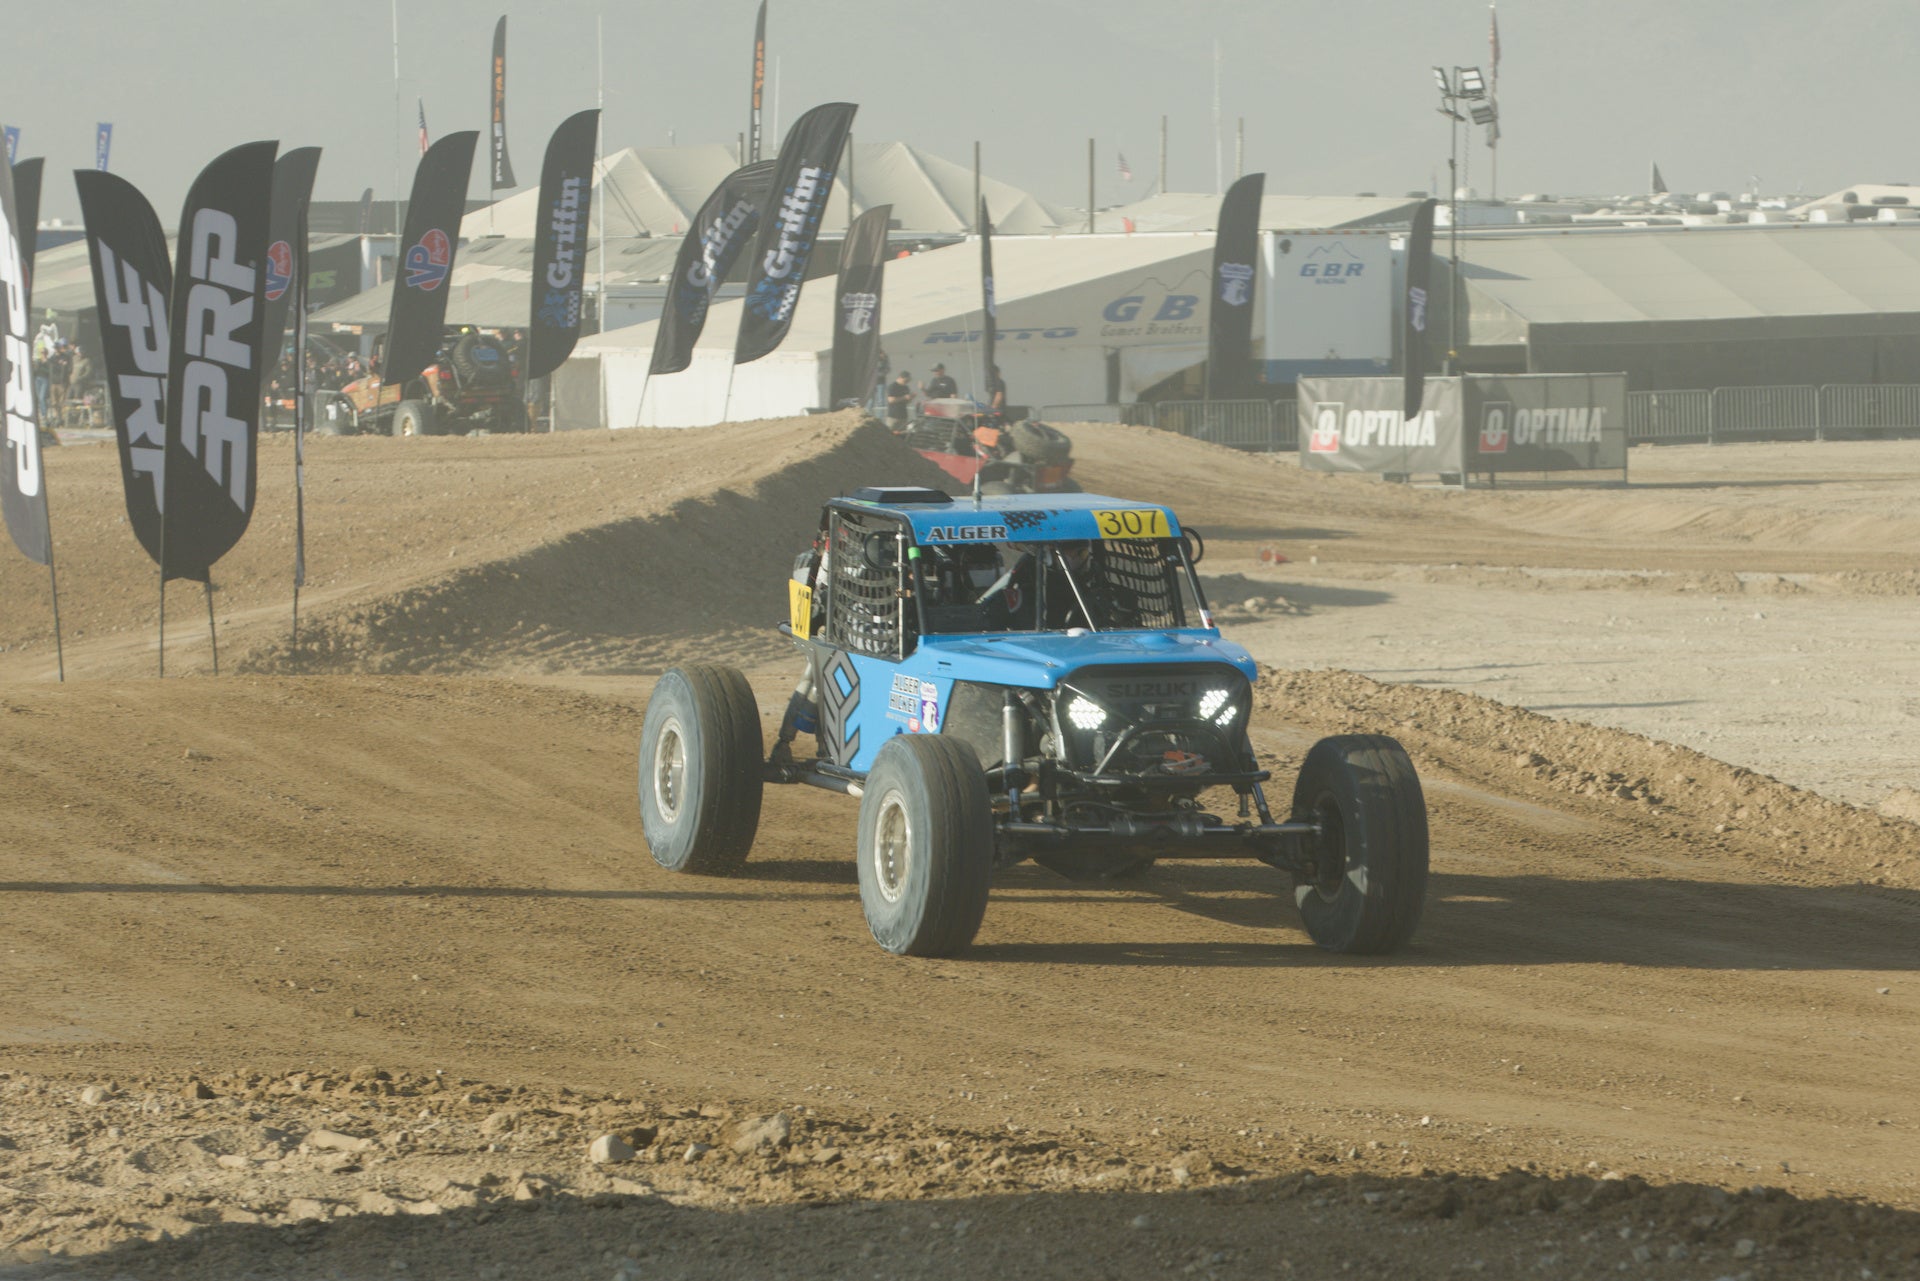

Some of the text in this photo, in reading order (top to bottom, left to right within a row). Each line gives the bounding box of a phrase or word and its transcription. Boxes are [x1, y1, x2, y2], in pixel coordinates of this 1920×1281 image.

[547, 176, 581, 289] Griffin
[763, 164, 822, 280] Griffin
[686, 198, 756, 289] Griffin
[405, 244, 448, 288] VP
[1299, 263, 1366, 277] GBR
[180, 208, 257, 514] PRP
[1345, 409, 1437, 447] OPTIMA
[1513, 407, 1603, 445] OPTIMA
[926, 525, 1009, 542] ALGER
[1099, 510, 1160, 536] 307
[889, 691, 918, 715] HICKEY
[893, 673, 919, 696] ALGER
[1106, 681, 1198, 699] SUZUKI
